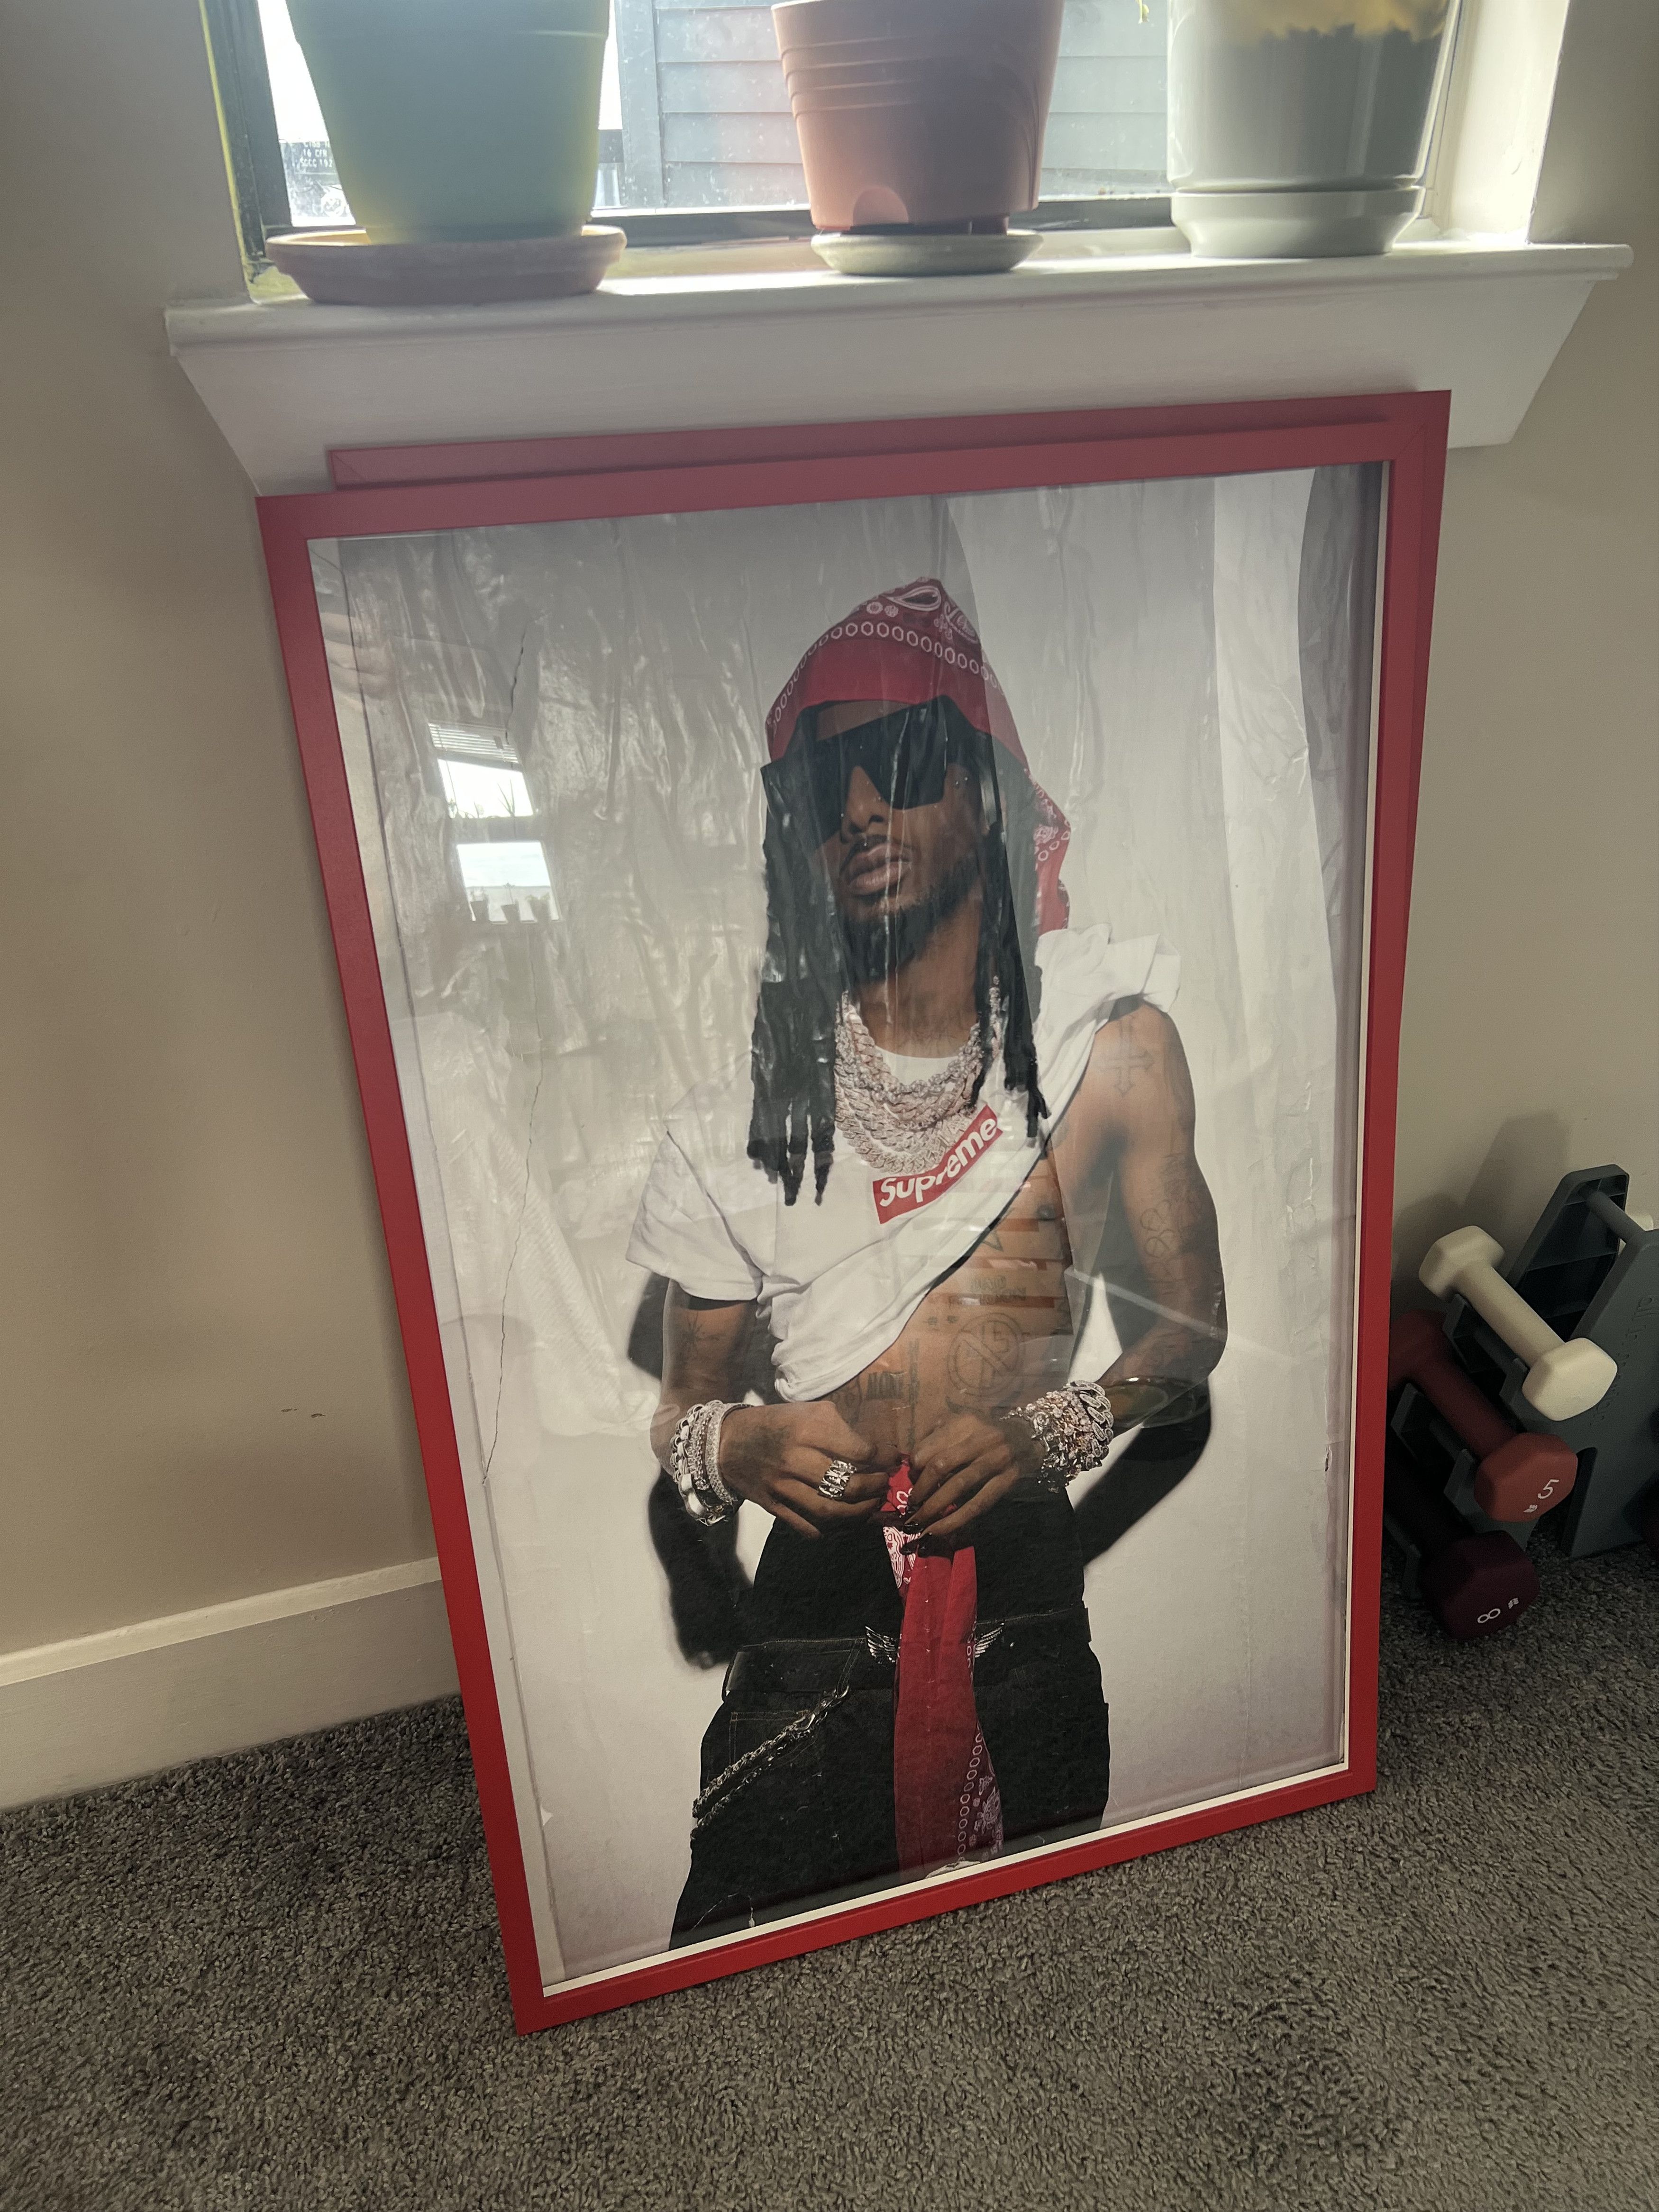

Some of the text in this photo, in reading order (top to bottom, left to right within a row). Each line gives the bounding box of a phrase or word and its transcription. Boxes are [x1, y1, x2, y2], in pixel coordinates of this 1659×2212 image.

[879, 1118, 997, 1207] Supreme
[1537, 1479, 1560, 1499] 5
[1477, 1608, 1501, 1624] 8
